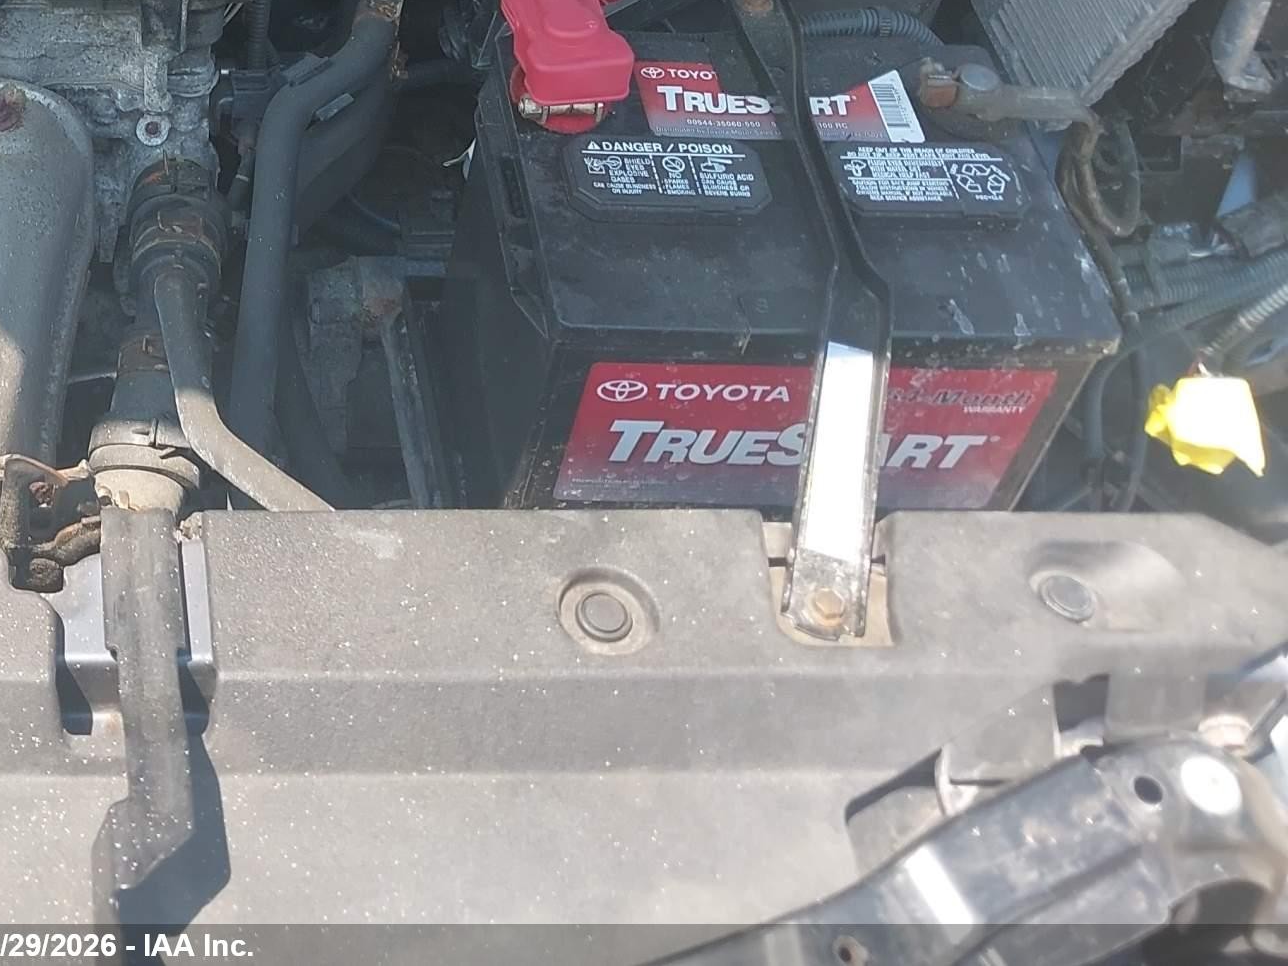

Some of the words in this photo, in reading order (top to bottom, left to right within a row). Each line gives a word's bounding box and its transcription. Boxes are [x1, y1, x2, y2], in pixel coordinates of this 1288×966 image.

[667, 68, 717, 80] TOYO
[602, 141, 662, 152] DANGER
[667, 143, 674, 152] /
[678, 143, 733, 154] POISON
[609, 169, 649, 178] EXPLOSIVE
[699, 172, 735, 180] SULFURIC
[736, 173, 754, 181] ACID
[655, 384, 790, 403] TOYOTA
[963, 405, 1026, 414] WARRANTY
